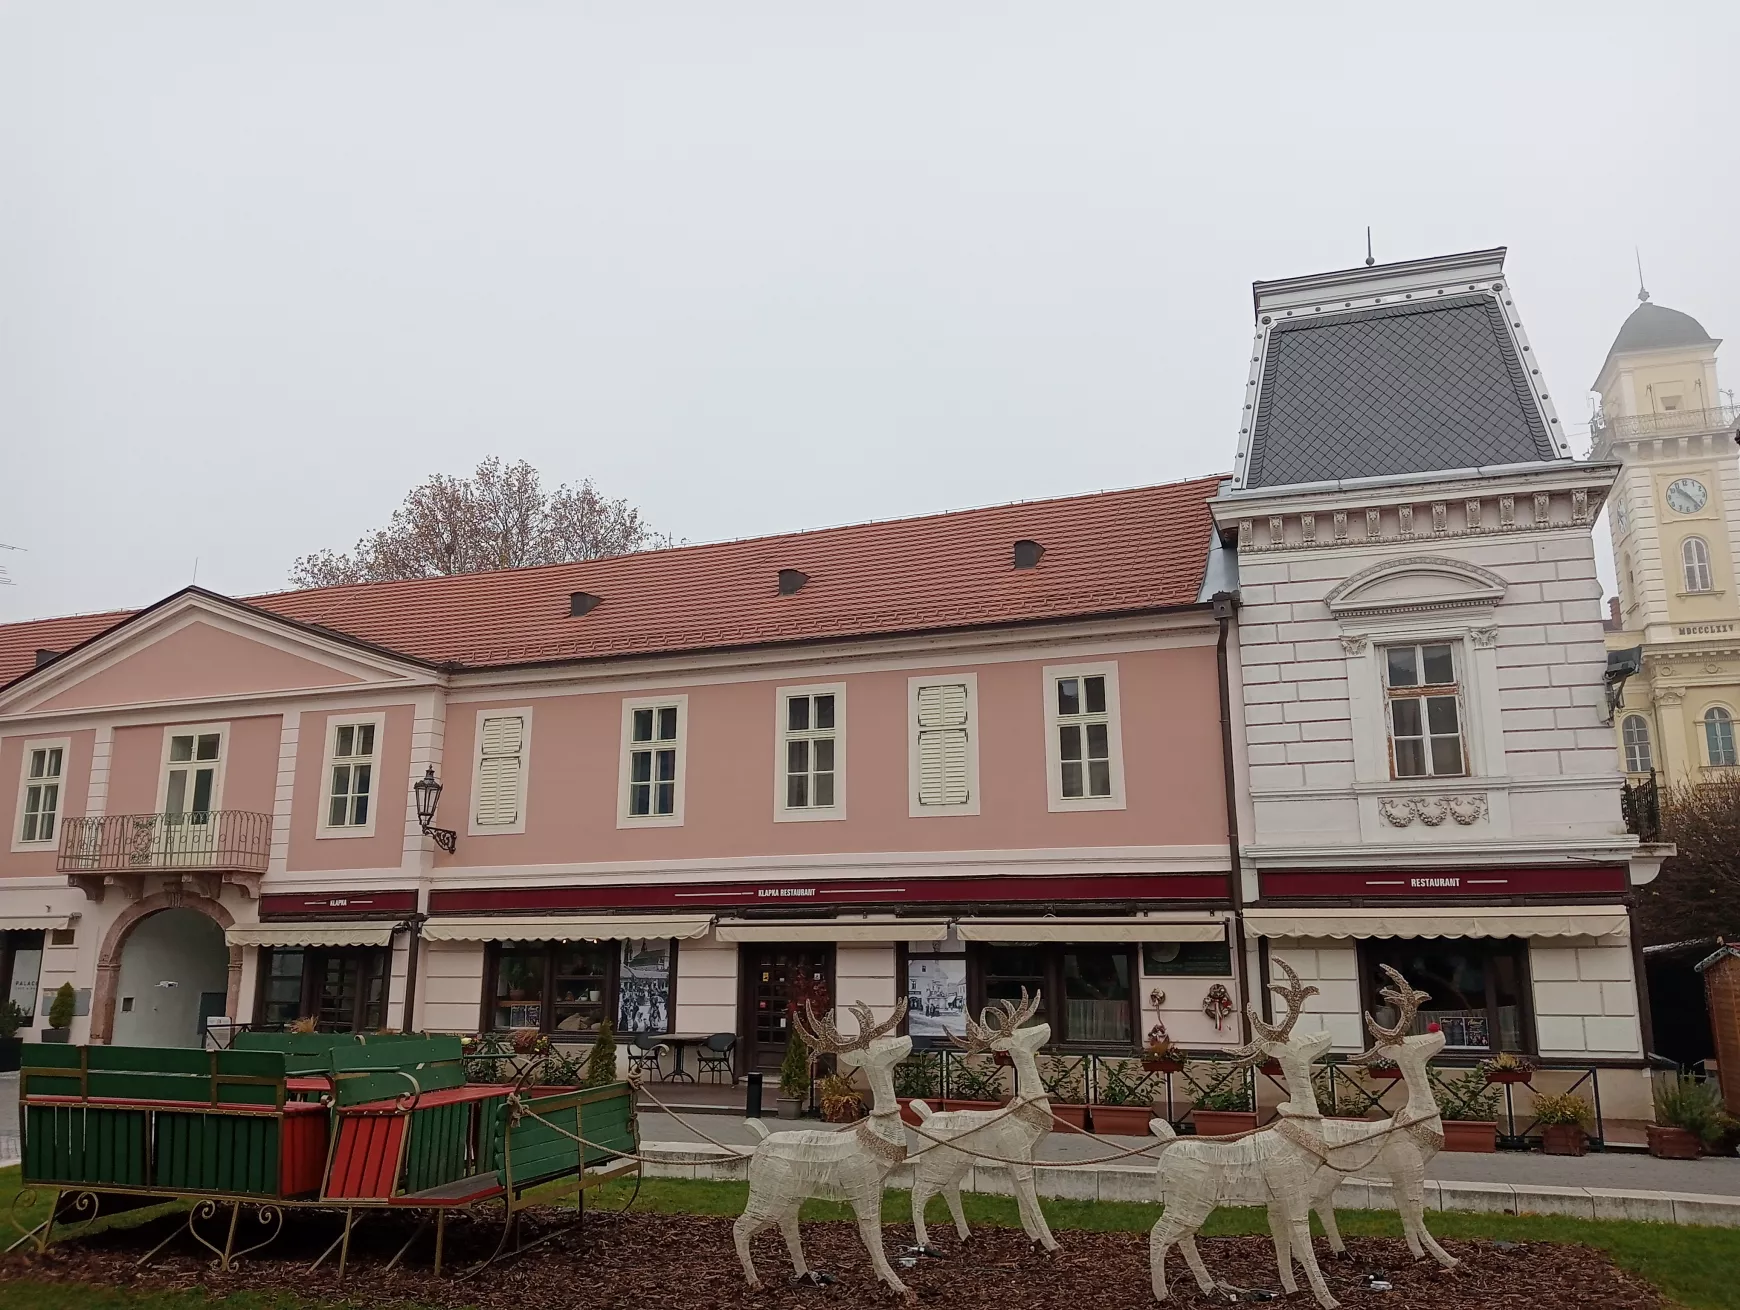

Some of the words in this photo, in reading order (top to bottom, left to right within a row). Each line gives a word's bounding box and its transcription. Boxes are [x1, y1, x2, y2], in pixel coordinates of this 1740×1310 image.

[1679, 624, 1733, 635] MDCCCLXXV
[1411, 878, 1460, 887] RESTAURANT
[758, 889, 779, 897] KLAPKA
[780, 888, 816, 897] RESTAURANT
